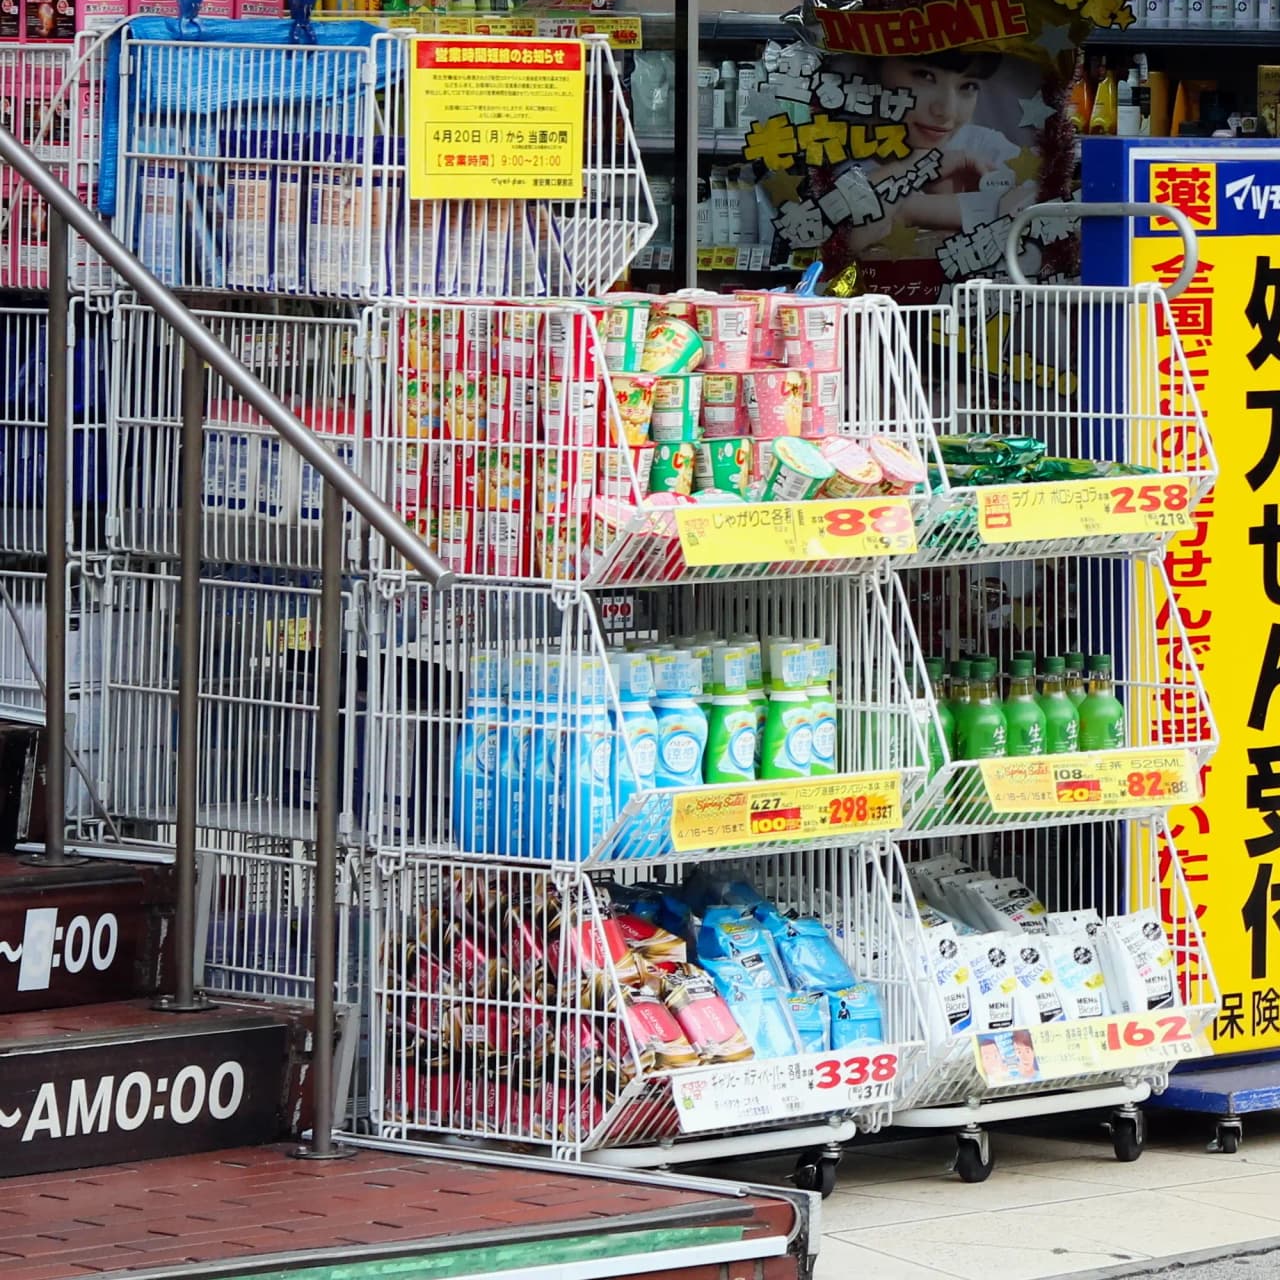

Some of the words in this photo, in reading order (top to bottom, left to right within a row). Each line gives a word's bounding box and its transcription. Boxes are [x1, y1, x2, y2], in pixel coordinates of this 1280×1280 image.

[1154, 167, 1211, 228] 薬
[1111, 484, 1188, 514] 258
[1159, 513, 1186, 527] 278
[1128, 771, 1164, 798] 82
[829, 796, 868, 824] 298
[1107, 1016, 1192, 1051] 162
[815, 1053, 898, 1089] 338
[863, 1084, 890, 1099] 371
